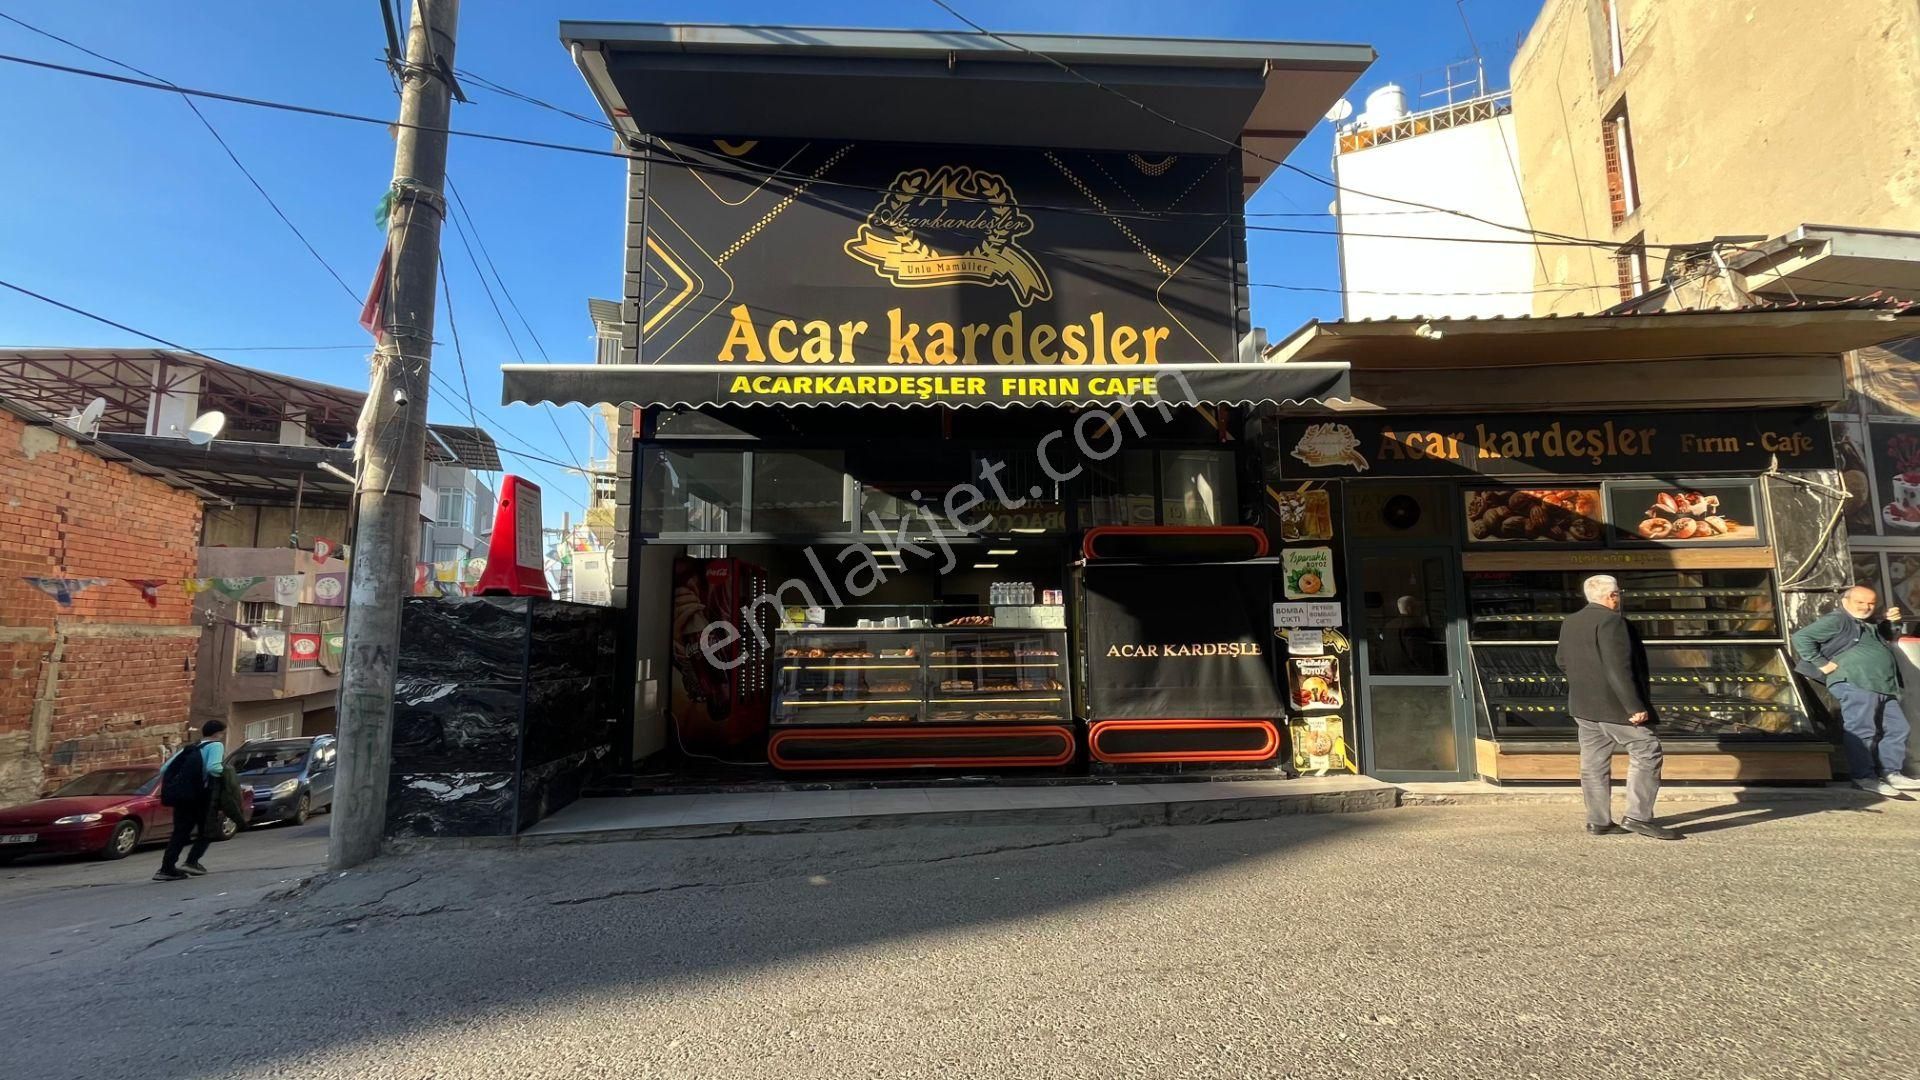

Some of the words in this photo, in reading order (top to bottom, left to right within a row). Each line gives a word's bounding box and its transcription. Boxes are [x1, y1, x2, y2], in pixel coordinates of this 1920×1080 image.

[717, 304, 868, 364] Acar
[729, 374, 986, 400] ACARKARDEŞLER
[1002, 378, 1079, 396] FIRIN
[1088, 377, 1159, 396] CAFE
[1377, 425, 1465, 460] Acar
[1475, 420, 1657, 465] kardeşler
[1761, 431, 1814, 456] Cafe
[1275, 607, 1304, 615] BOMBA
[1280, 616, 1301, 624] ÇIKTI
[1107, 644, 1158, 657] ACAR
